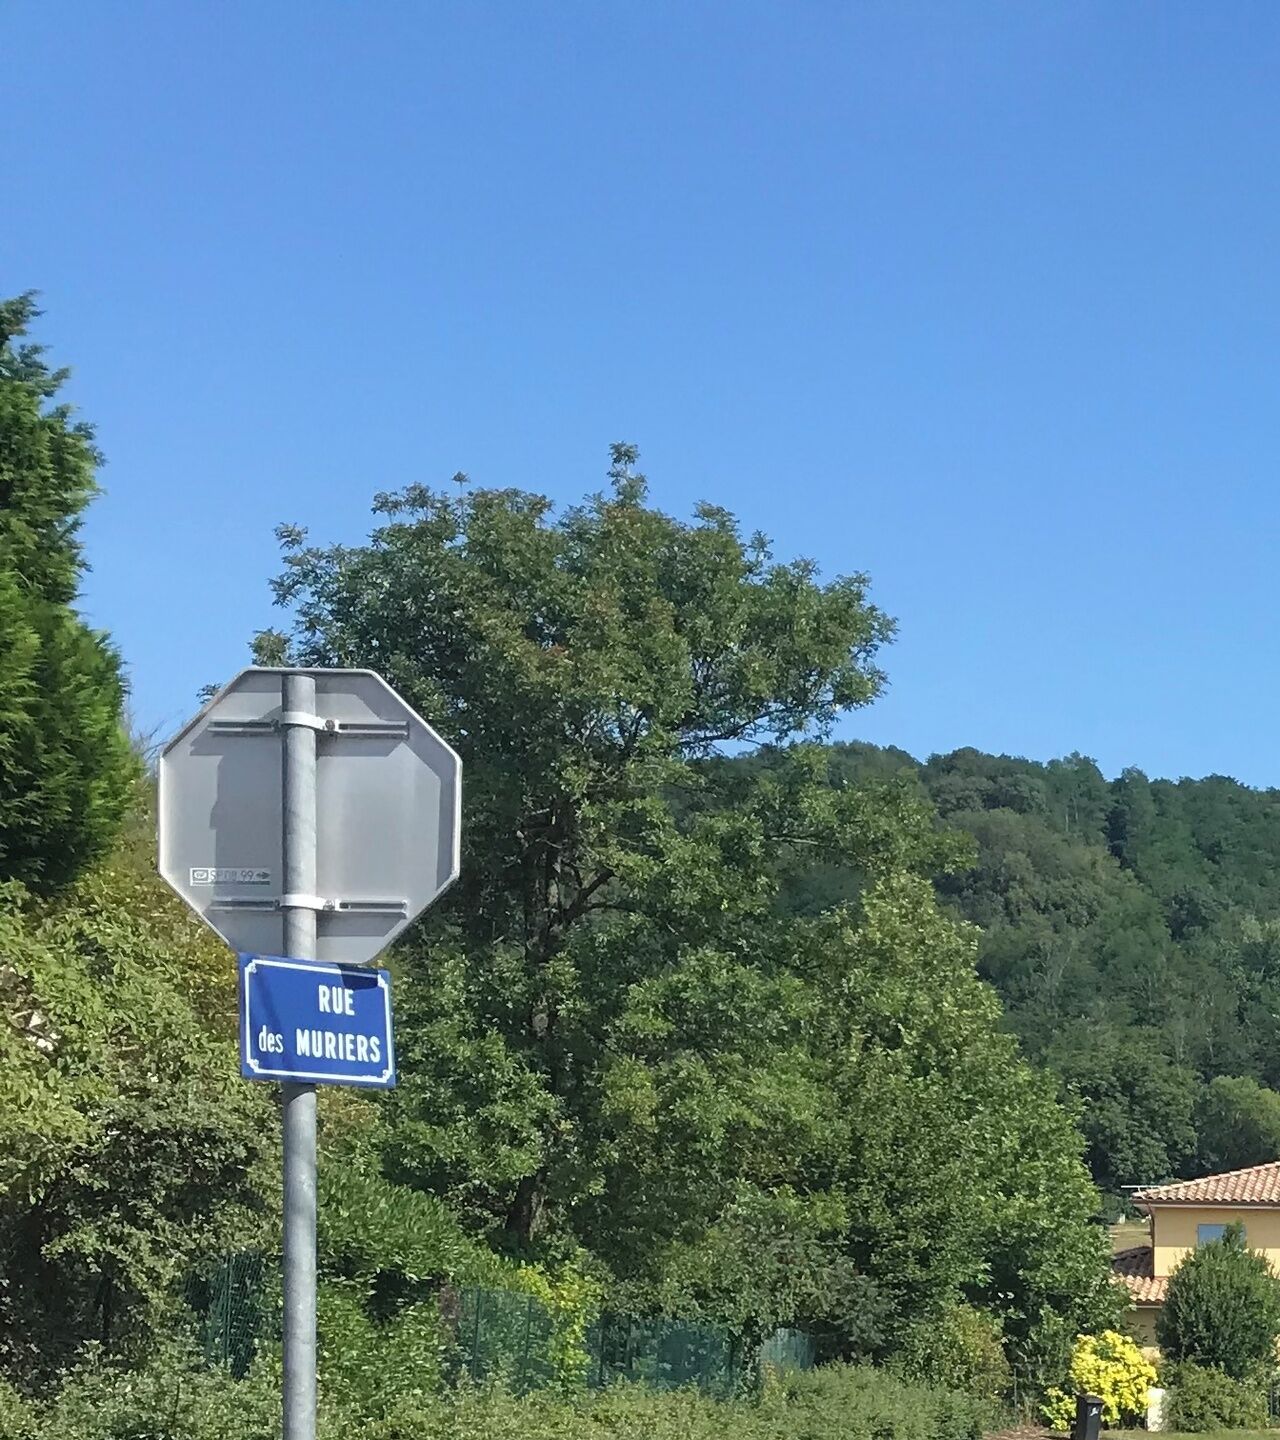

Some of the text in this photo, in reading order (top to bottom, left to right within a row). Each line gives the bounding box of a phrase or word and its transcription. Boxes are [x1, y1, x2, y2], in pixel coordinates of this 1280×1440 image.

[318, 985, 356, 1016] RUE
[258, 1025, 381, 1063] des MURIERS
